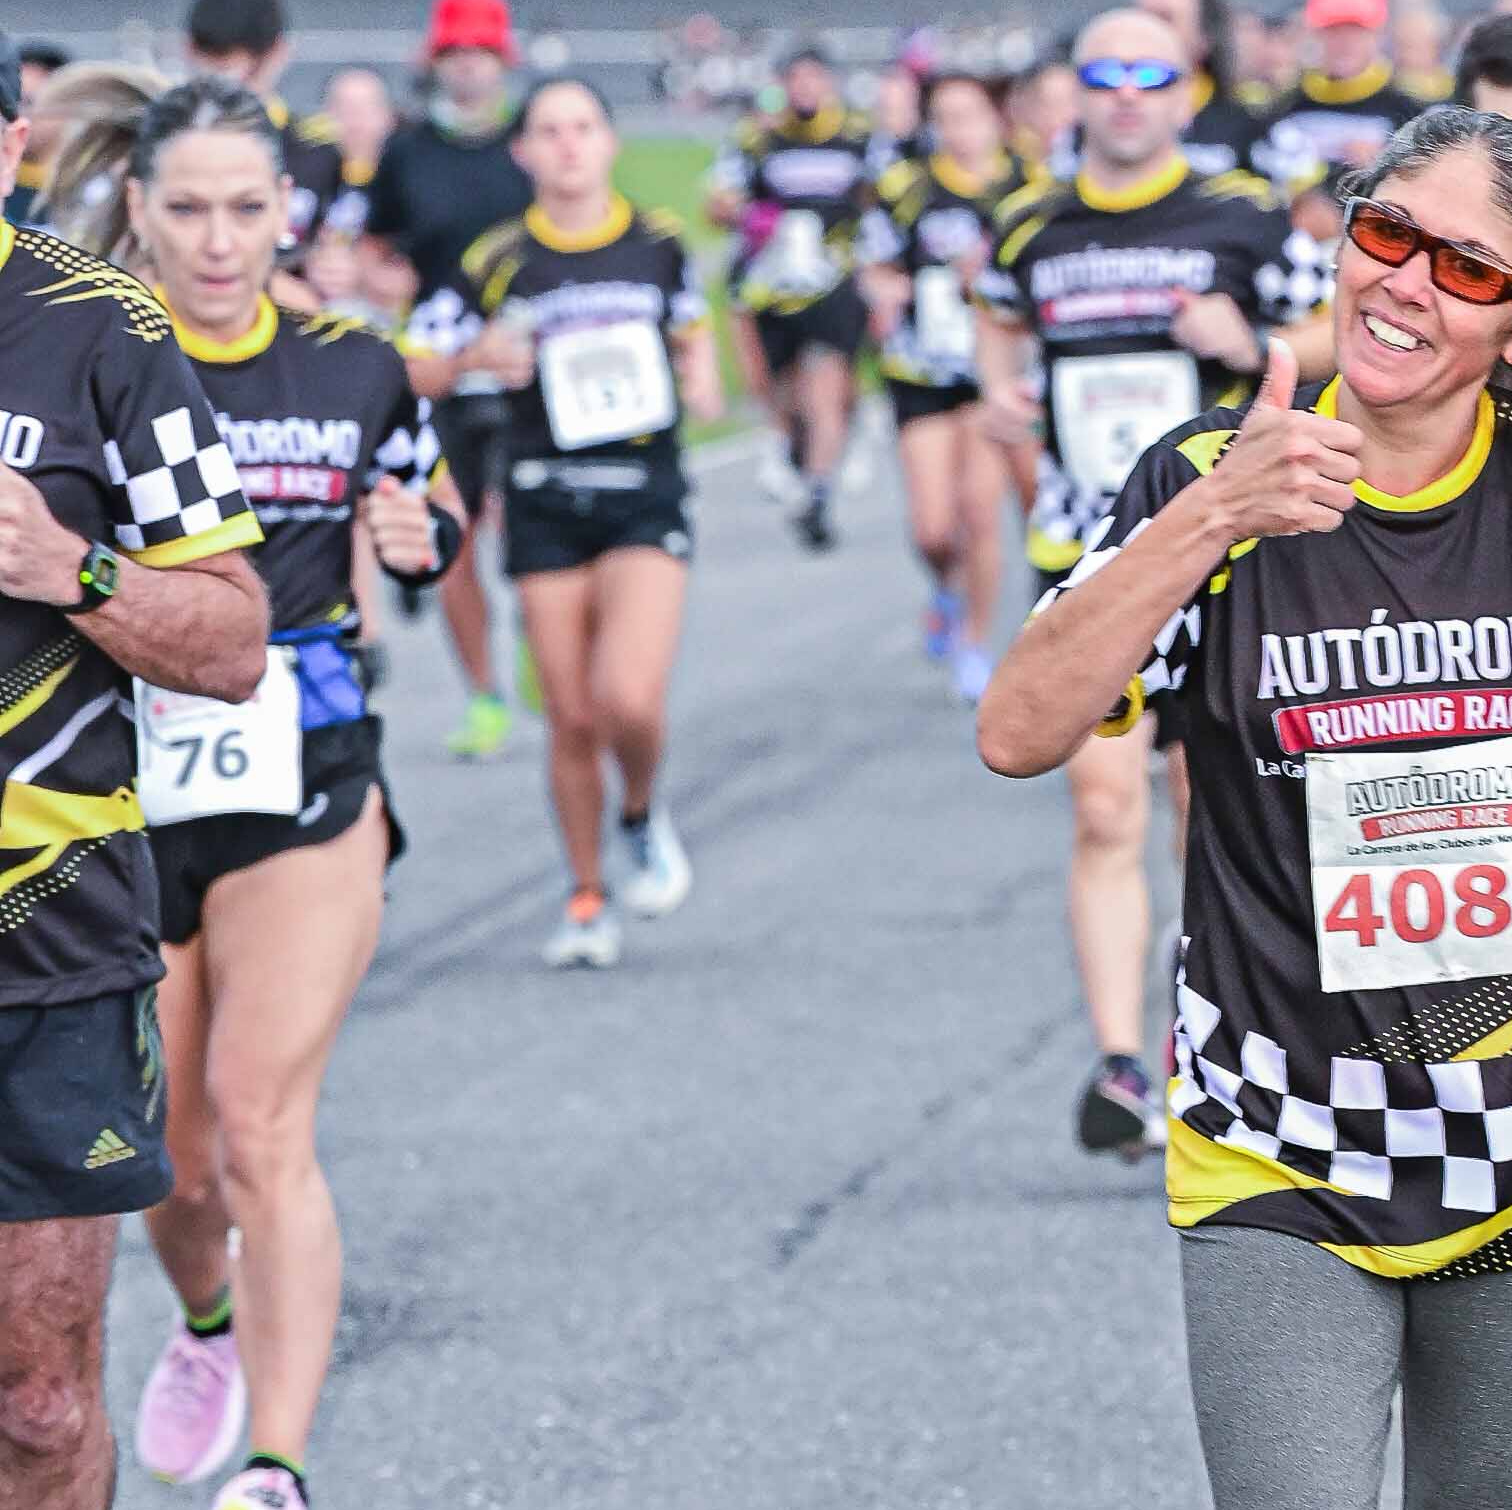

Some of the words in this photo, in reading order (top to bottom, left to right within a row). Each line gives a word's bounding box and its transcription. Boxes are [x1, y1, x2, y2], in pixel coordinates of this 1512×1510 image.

[1306, 696, 1455, 745] RUNNING
[168, 728, 249, 788] 76
[1255, 757, 1280, 777] La
[1377, 810, 1458, 837] RUNNING
[1461, 807, 1509, 827] RACE
